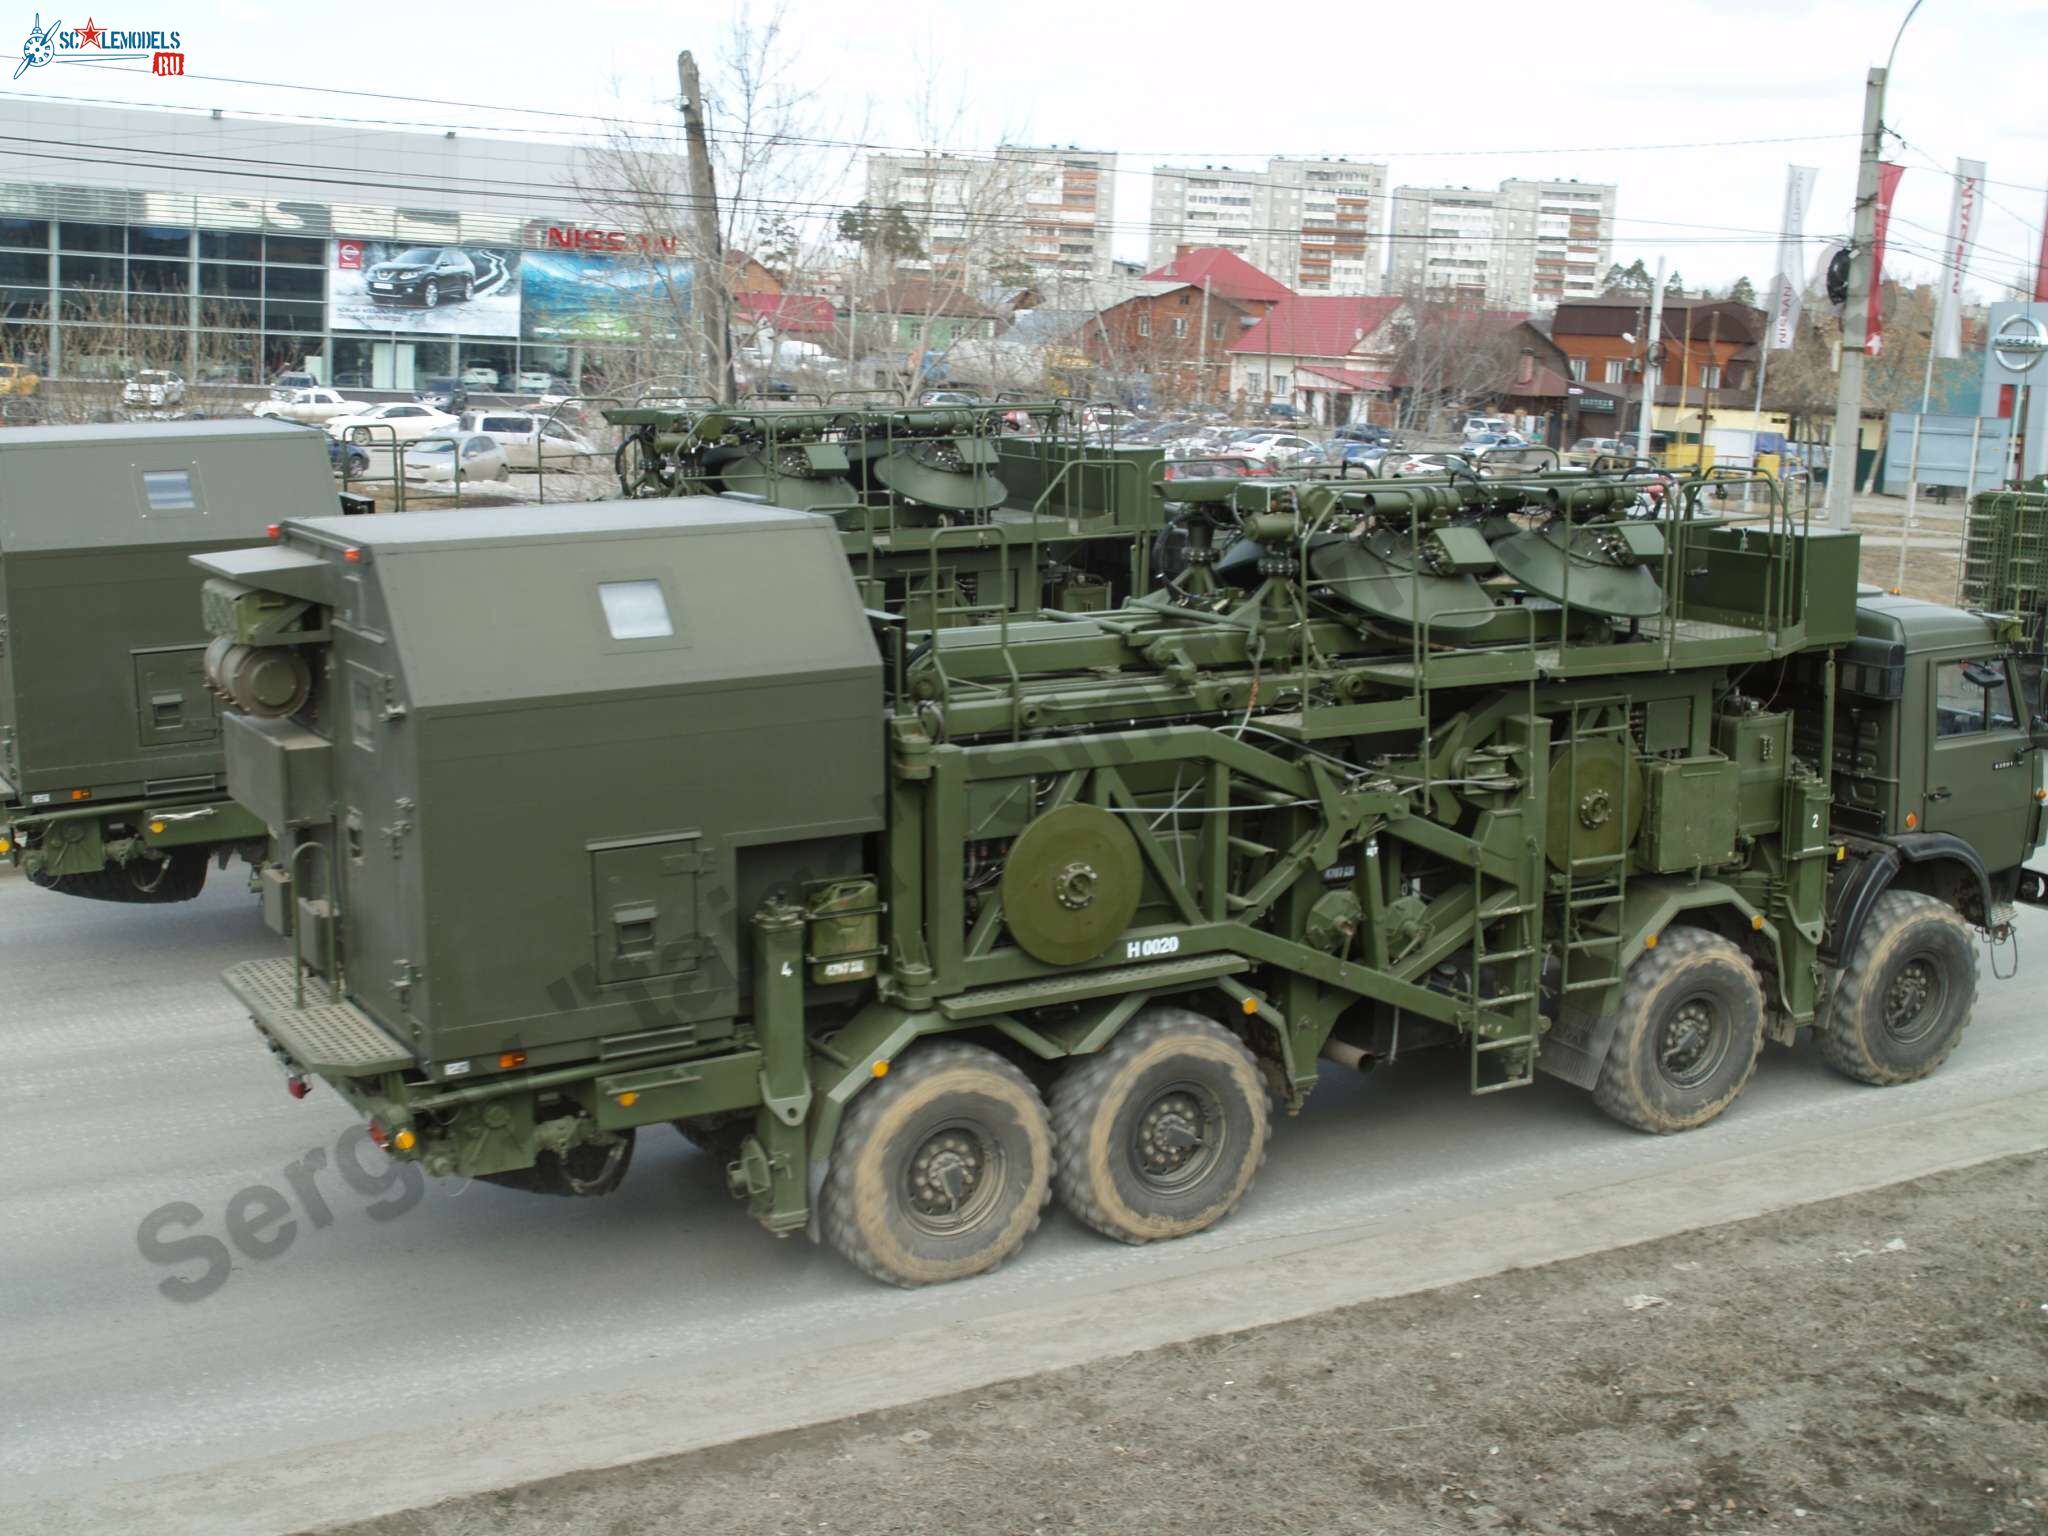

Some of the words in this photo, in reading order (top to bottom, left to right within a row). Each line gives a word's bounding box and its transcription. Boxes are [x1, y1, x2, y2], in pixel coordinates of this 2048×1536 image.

[1778, 286, 1793, 344] NISSAN
[1811, 813, 1820, 829] 2
[1142, 936, 1179, 956] 0020
[780, 960, 794, 977] 4
